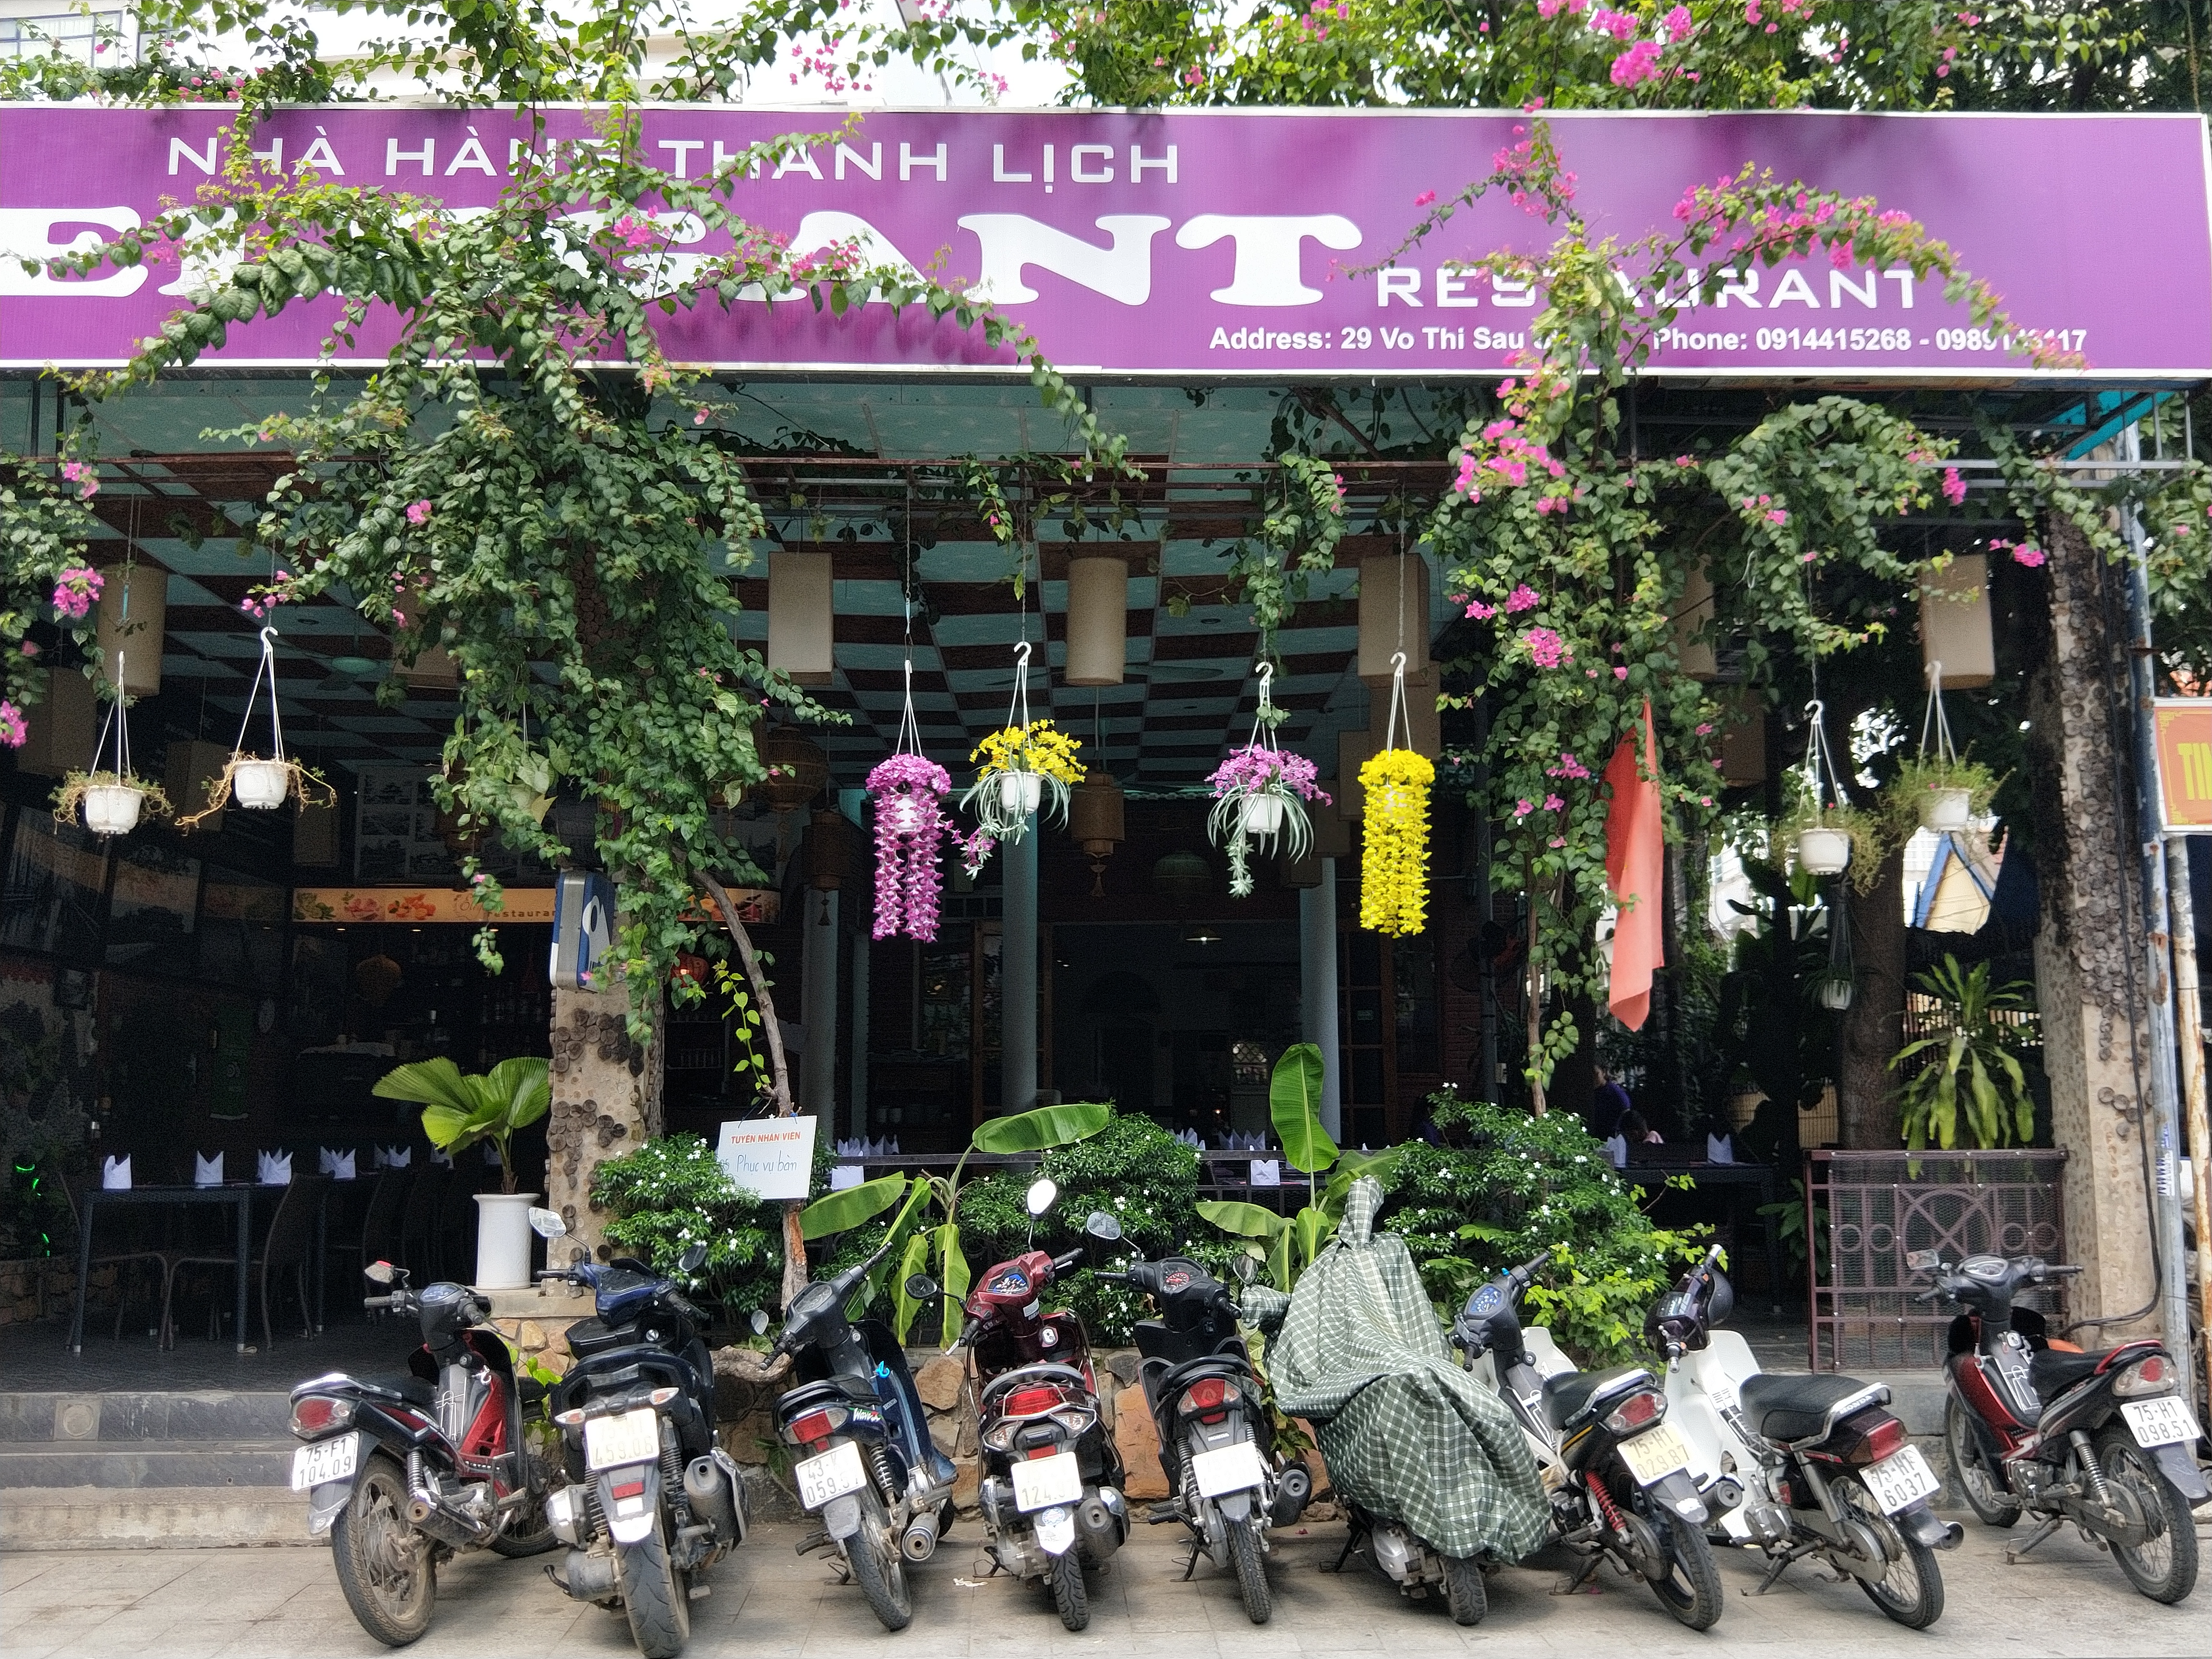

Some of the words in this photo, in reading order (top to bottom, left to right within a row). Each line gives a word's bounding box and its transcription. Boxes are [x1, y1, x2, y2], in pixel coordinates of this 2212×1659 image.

[168, 126, 346, 176] NHÀ
[658, 140, 947, 181] THANH
[993, 144, 1178, 193] LỊCH
[1209, 326, 1332, 350] Address:
[1340, 327, 1373, 350] 29
[1379, 327, 1414, 350] Vo
[1422, 327, 1465, 350] Thi
[1473, 327, 1525, 350] Sau
[1653, 327, 1747, 350] Phone:
[1755, 327, 1912, 351] 0914415268
[2133, 1401, 2178, 1422] 75-H1
[1628, 1428, 1673, 1458] 75-H1
[2138, 1419, 2194, 1443] 098.51
[307, 1438, 347, 1464] 75-F1
[300, 1456, 352, 1486] 104.09
[1883, 1472, 1926, 1507] 6037
